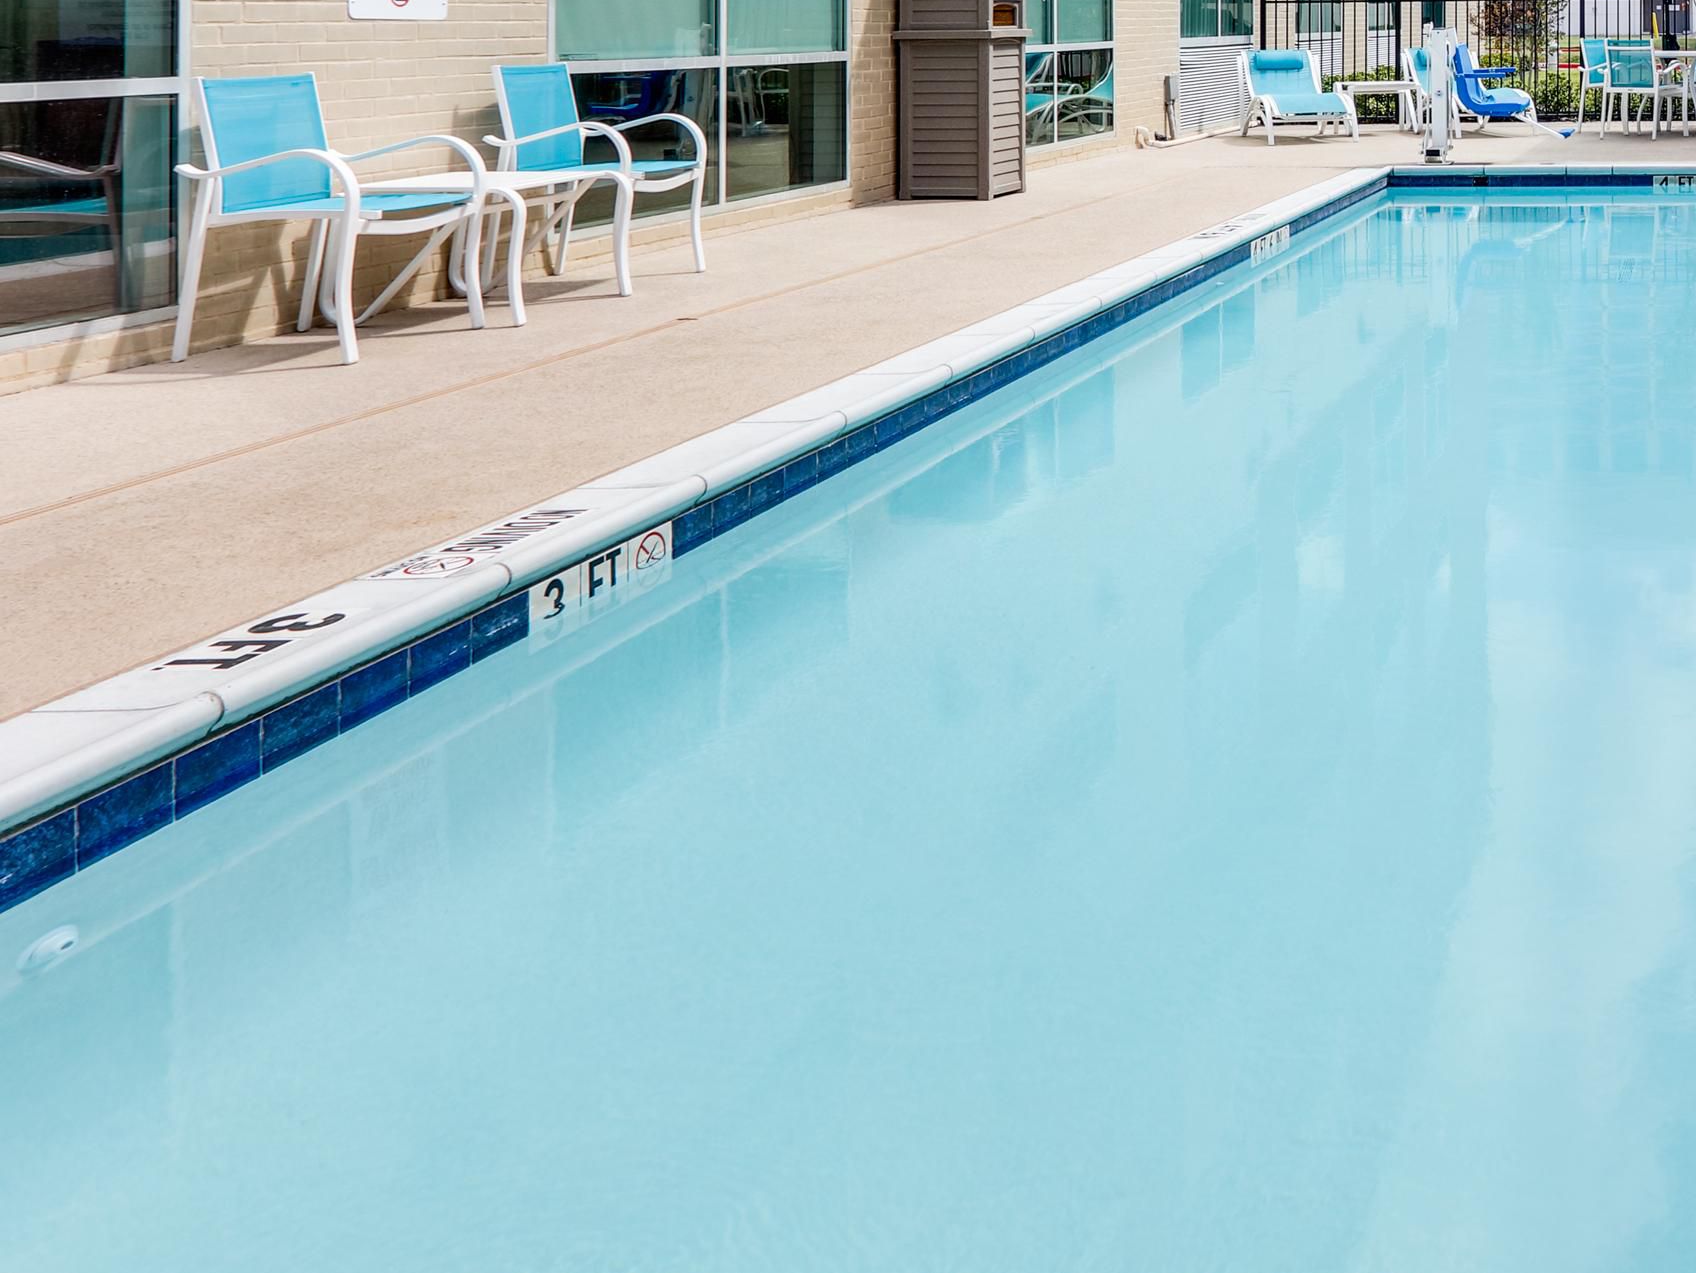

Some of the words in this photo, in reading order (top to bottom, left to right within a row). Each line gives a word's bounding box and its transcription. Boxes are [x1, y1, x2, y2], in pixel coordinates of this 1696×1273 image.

[520, 509, 589, 520] NO
[439, 520, 562, 553] DIVING
[544, 578, 565, 620] 3
[588, 547, 621, 598] FT
[248, 613, 346, 634] 3
